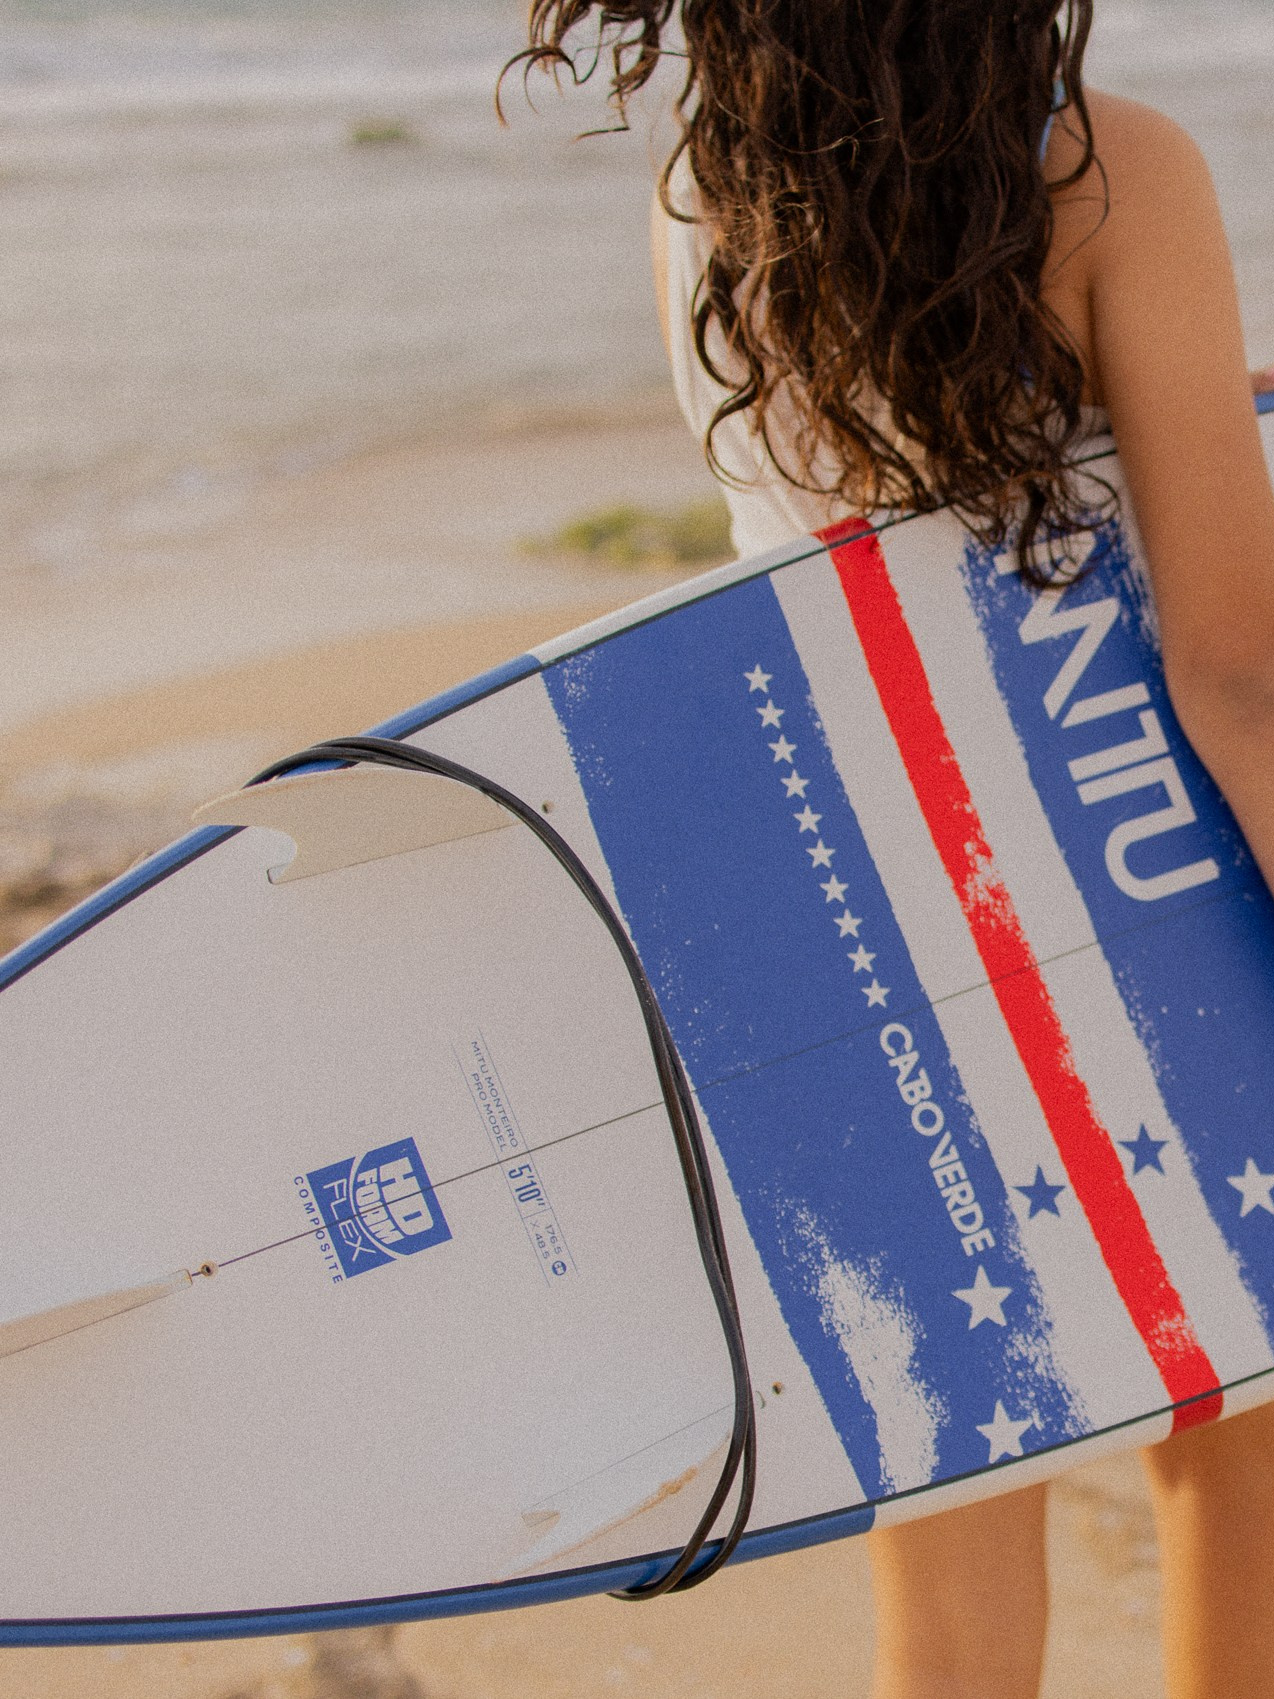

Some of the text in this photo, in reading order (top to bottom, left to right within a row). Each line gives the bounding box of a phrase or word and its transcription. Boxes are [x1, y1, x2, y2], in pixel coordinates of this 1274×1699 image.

[991, 530, 1220, 901] MITU
[471, 1040, 518, 1148] MITU MONTEIRO
[471, 1072, 507, 1152] PRO MODEL
[880, 1023, 996, 1257] CABO VERDE
[294, 1176, 343, 1284] COMPOSITE
[323, 1178, 376, 1261] FLEX
[356, 1168, 405, 1245] FOAM
[379, 1156, 434, 1236] HD
